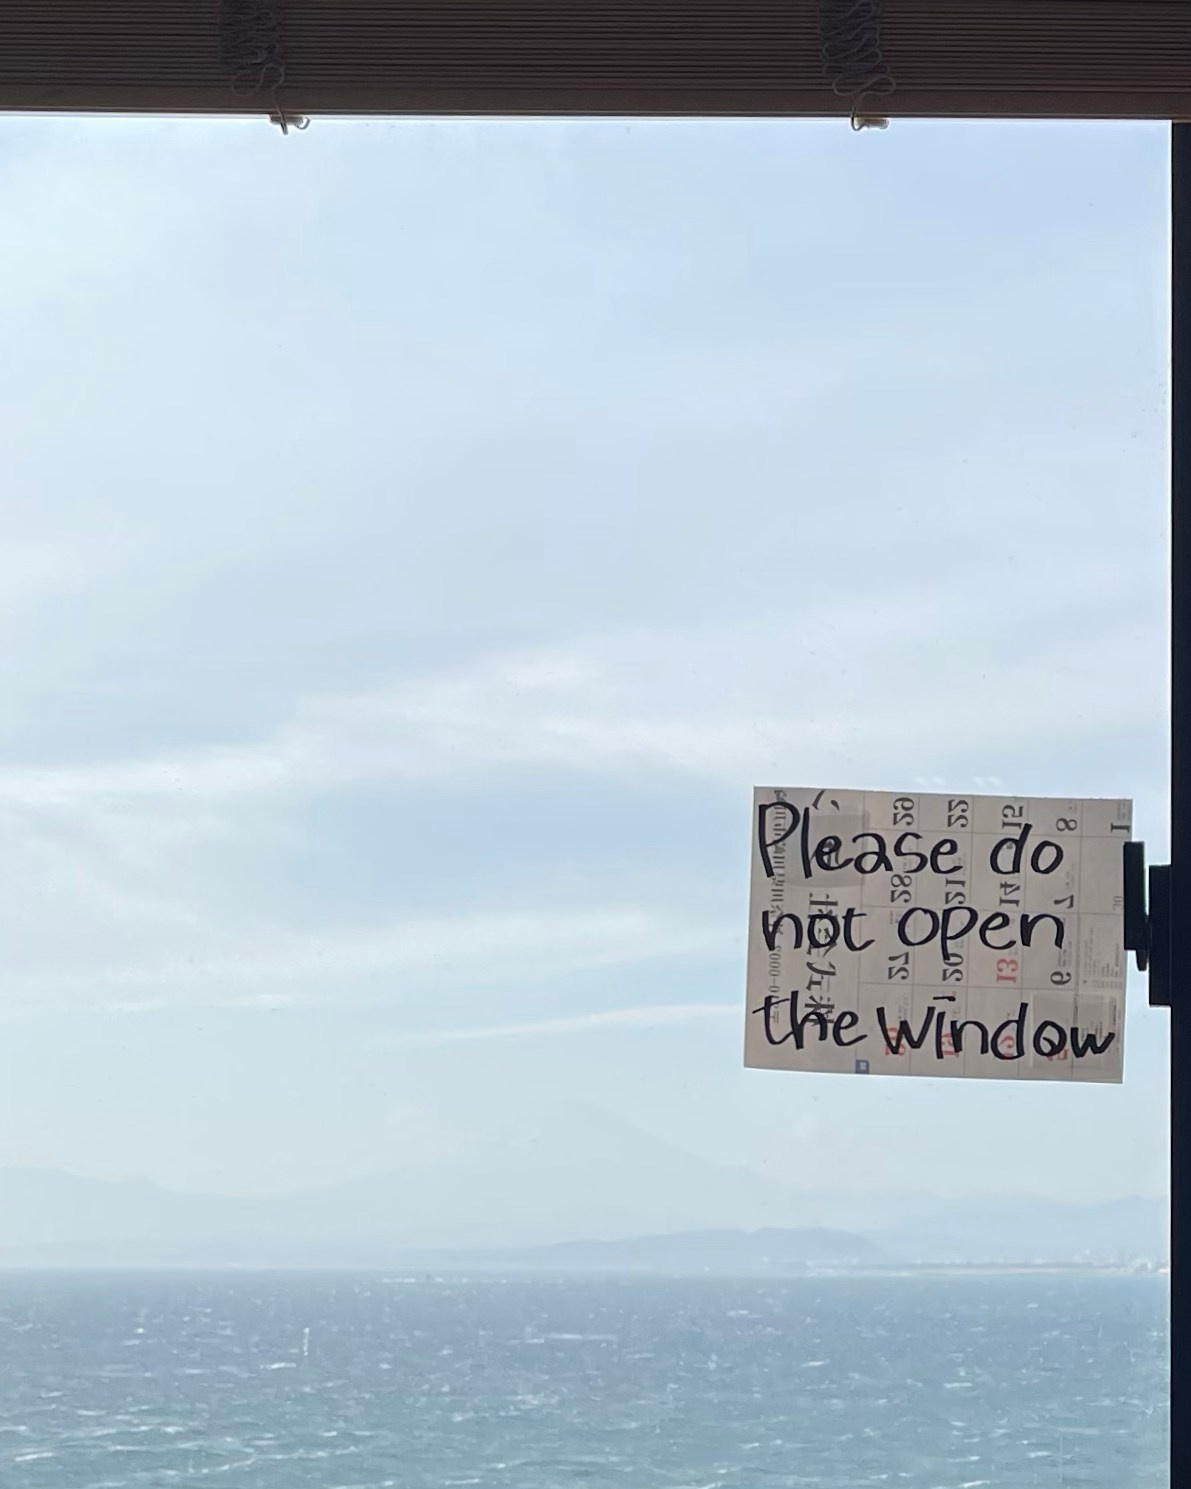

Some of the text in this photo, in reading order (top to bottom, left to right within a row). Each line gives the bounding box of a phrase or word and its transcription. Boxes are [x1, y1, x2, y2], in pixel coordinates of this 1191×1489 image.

[758, 802, 964, 878] Please
[989, 823, 1065, 877] do
[762, 905, 1065, 961] not open
[752, 991, 867, 1051] the
